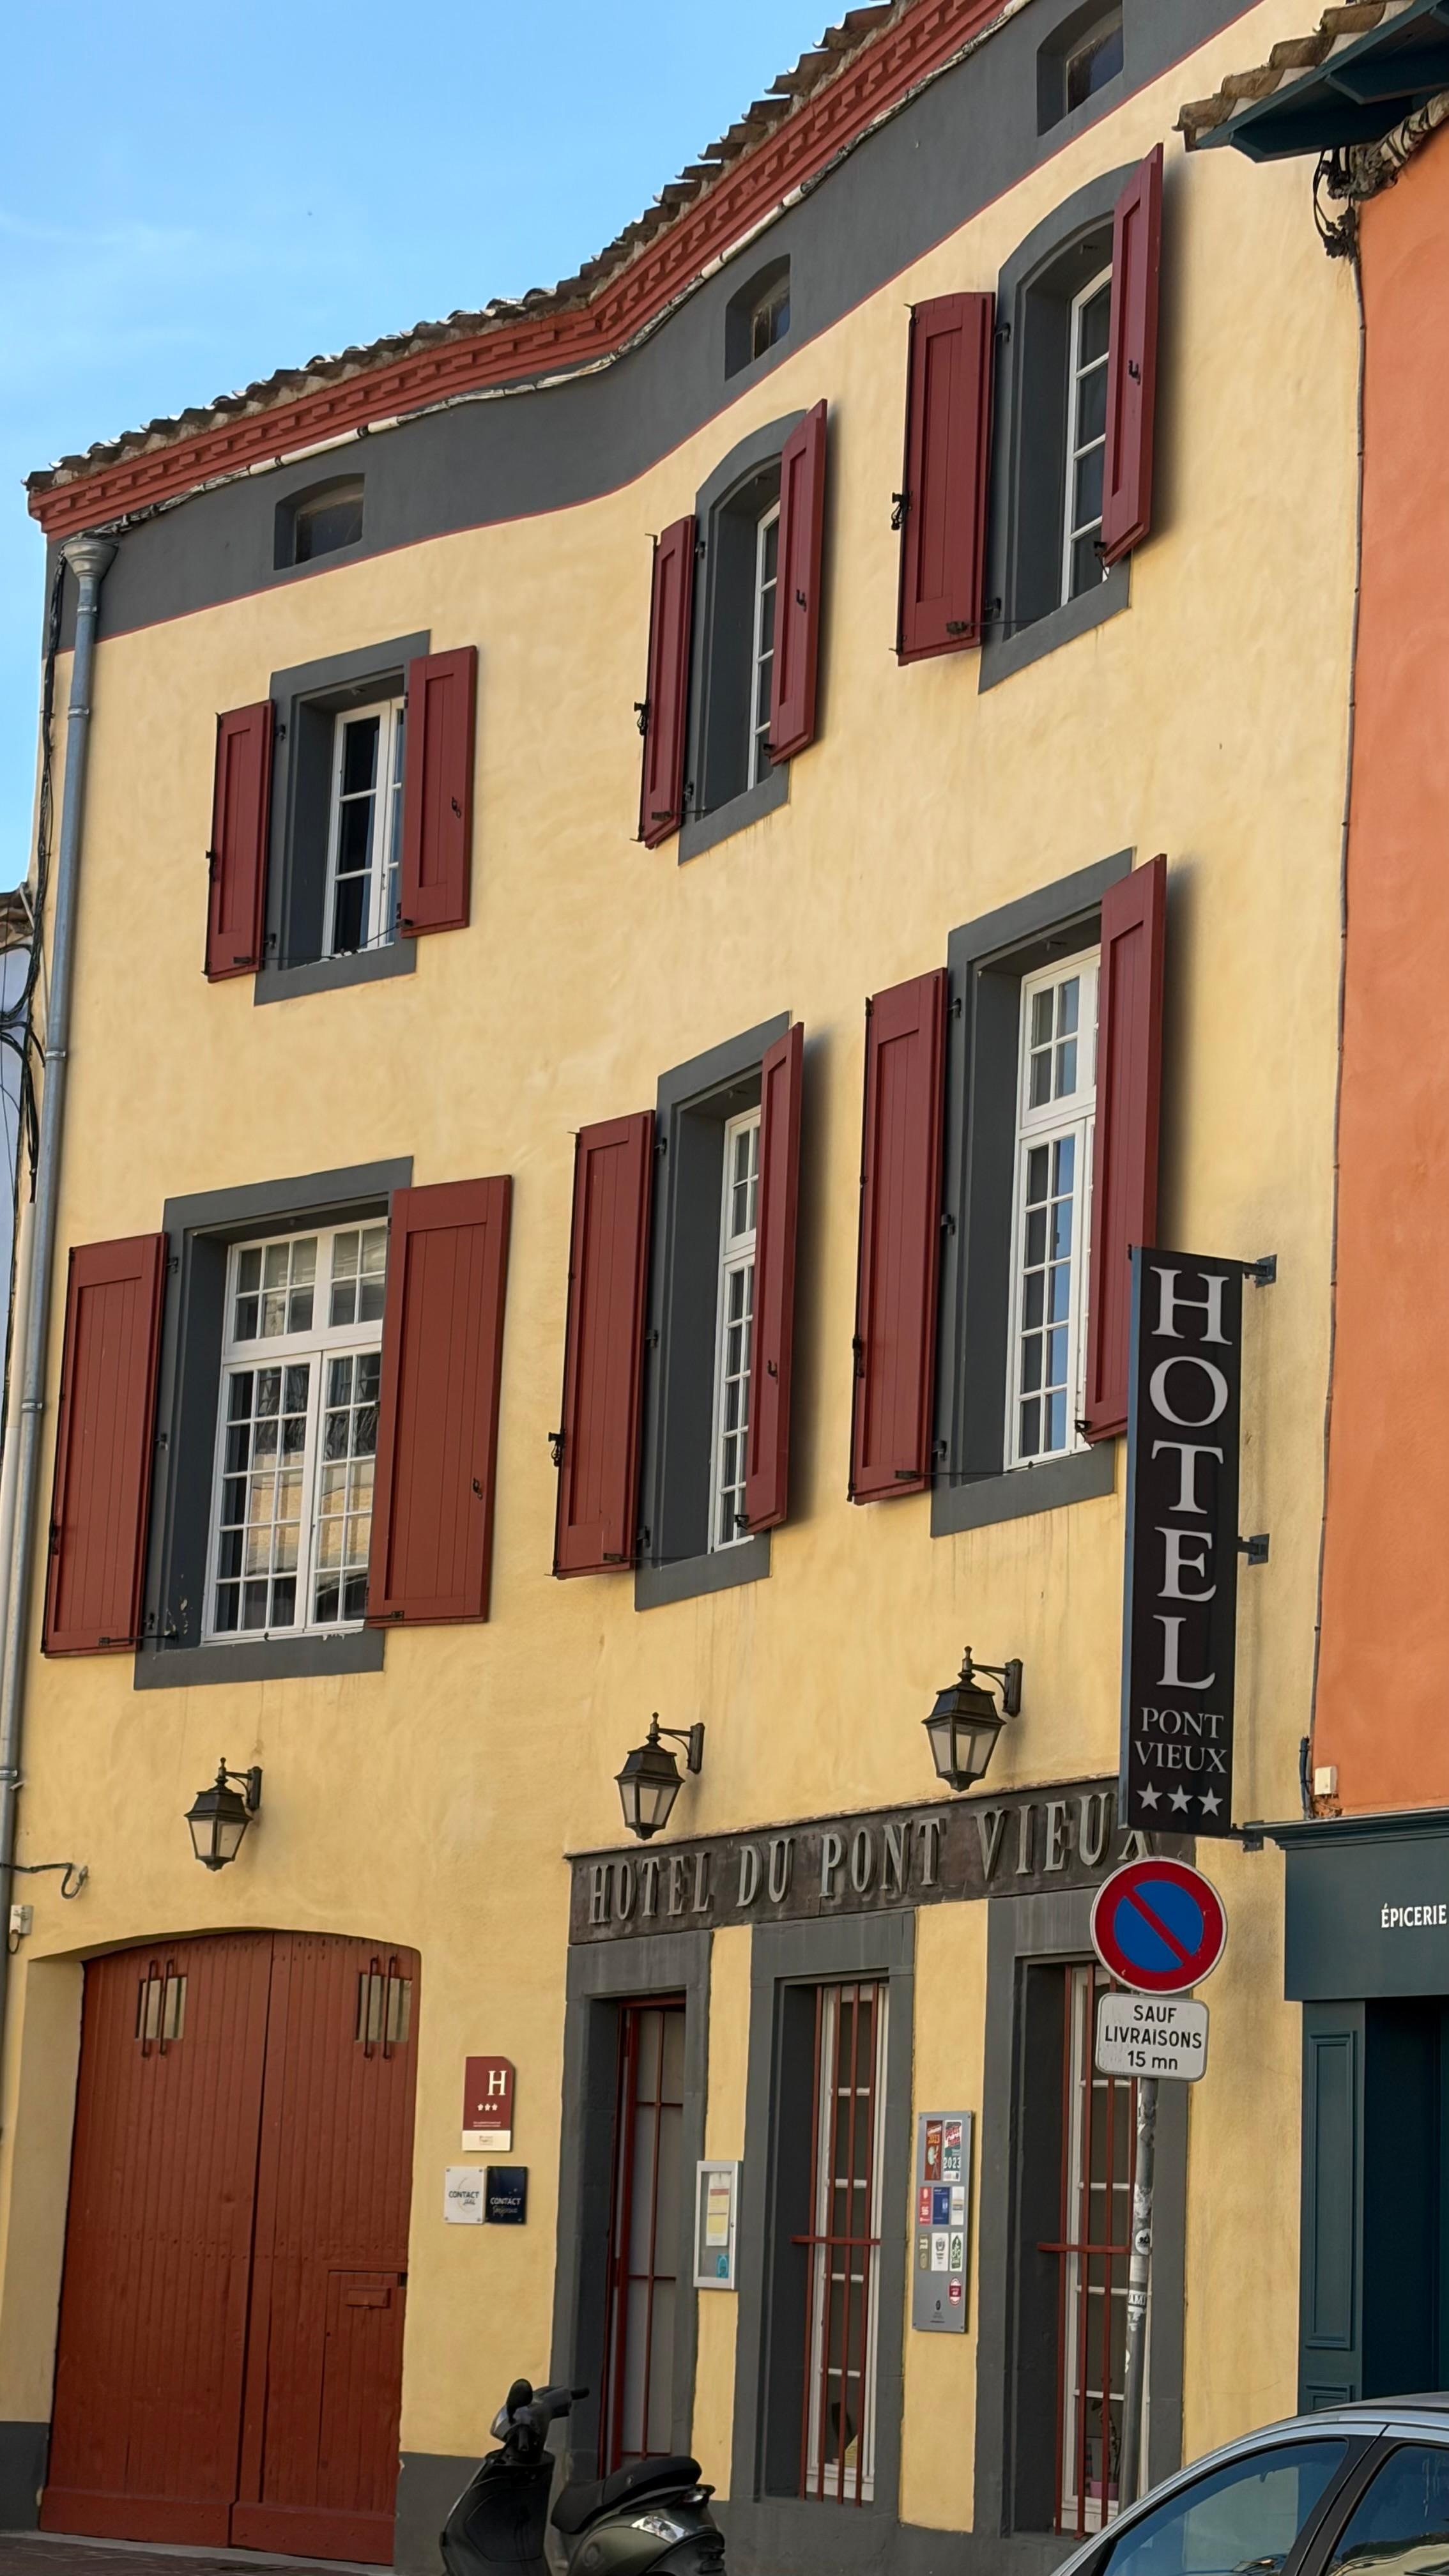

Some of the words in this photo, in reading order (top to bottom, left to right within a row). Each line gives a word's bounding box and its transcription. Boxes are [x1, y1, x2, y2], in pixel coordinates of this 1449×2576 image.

[1149, 1266, 1232, 1690] HOTEL
[1140, 1706, 1224, 1738] PONT
[1135, 1740, 1228, 1774] VIEUX
[589, 1852, 713, 1924] HOTEL
[735, 1837, 795, 1907] DU
[819, 1818, 946, 1897] PONT
[1381, 1902, 1447, 1928] ÉPICERIE
[1133, 2005, 1177, 2023] SAUF
[1105, 2025, 1202, 2049] LIVRAISONS
[1128, 2050, 1146, 2067] 15
[1152, 2056, 1178, 2070] mn
[487, 2070, 507, 2096] H
[943, 2156, 961, 2169] 2023
[448, 2190, 480, 2198] CONTACT
[490, 2197, 521, 2205] CONTACT
